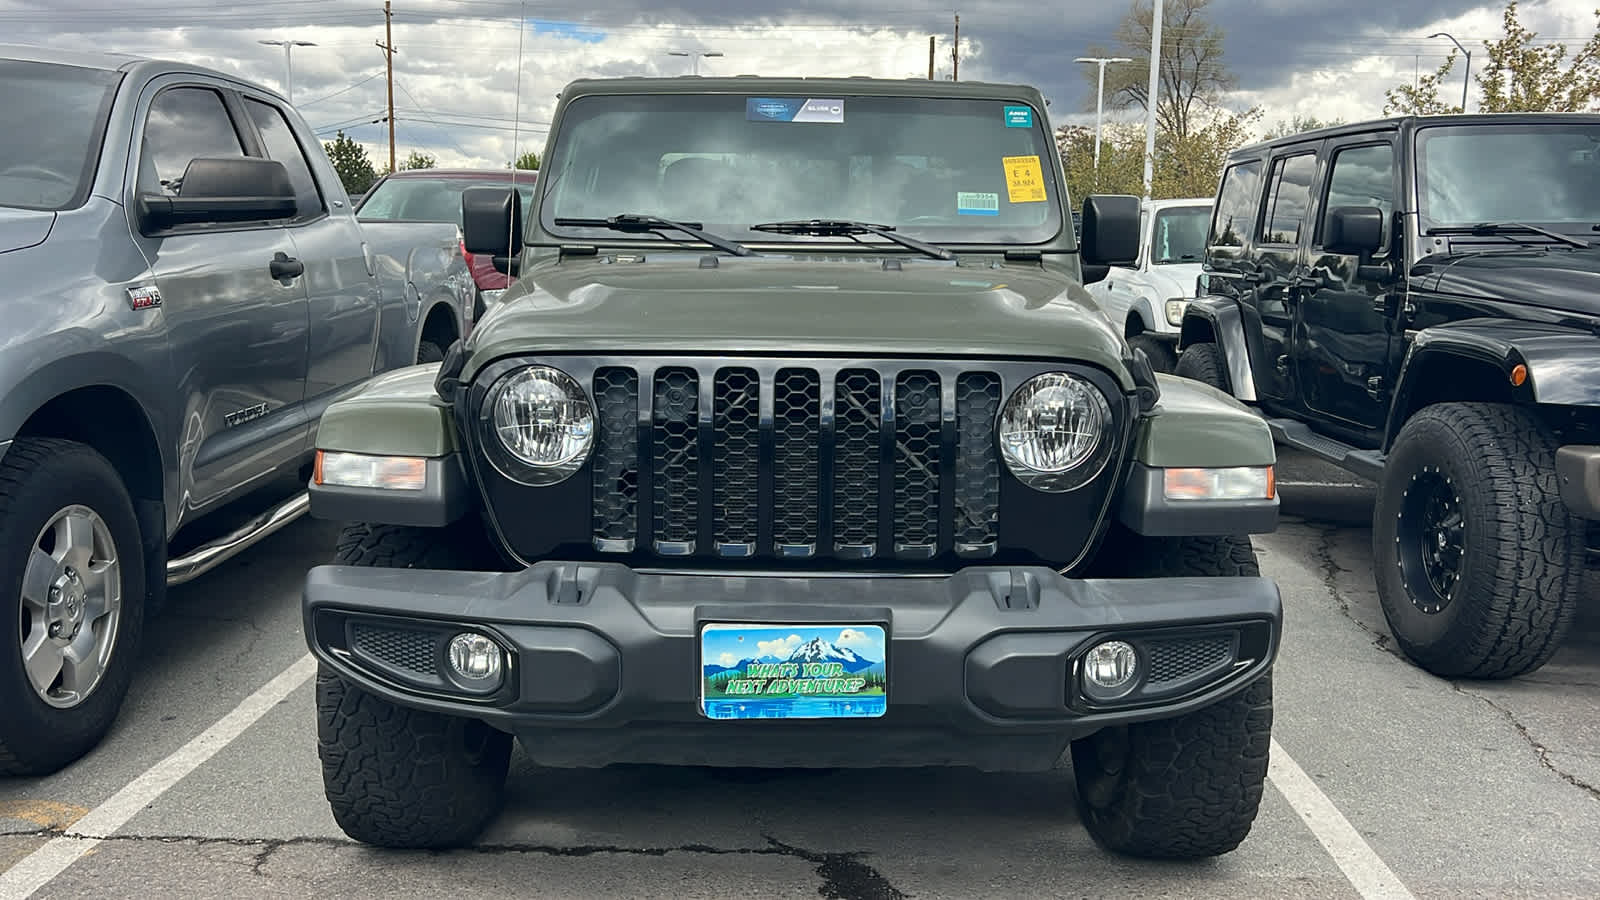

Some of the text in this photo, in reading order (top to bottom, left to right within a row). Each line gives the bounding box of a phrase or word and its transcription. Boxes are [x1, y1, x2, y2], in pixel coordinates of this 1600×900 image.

[748, 662, 843, 678] WHAT'S YOUR
[726, 678, 865, 694] NEXT ADVENTURE?
